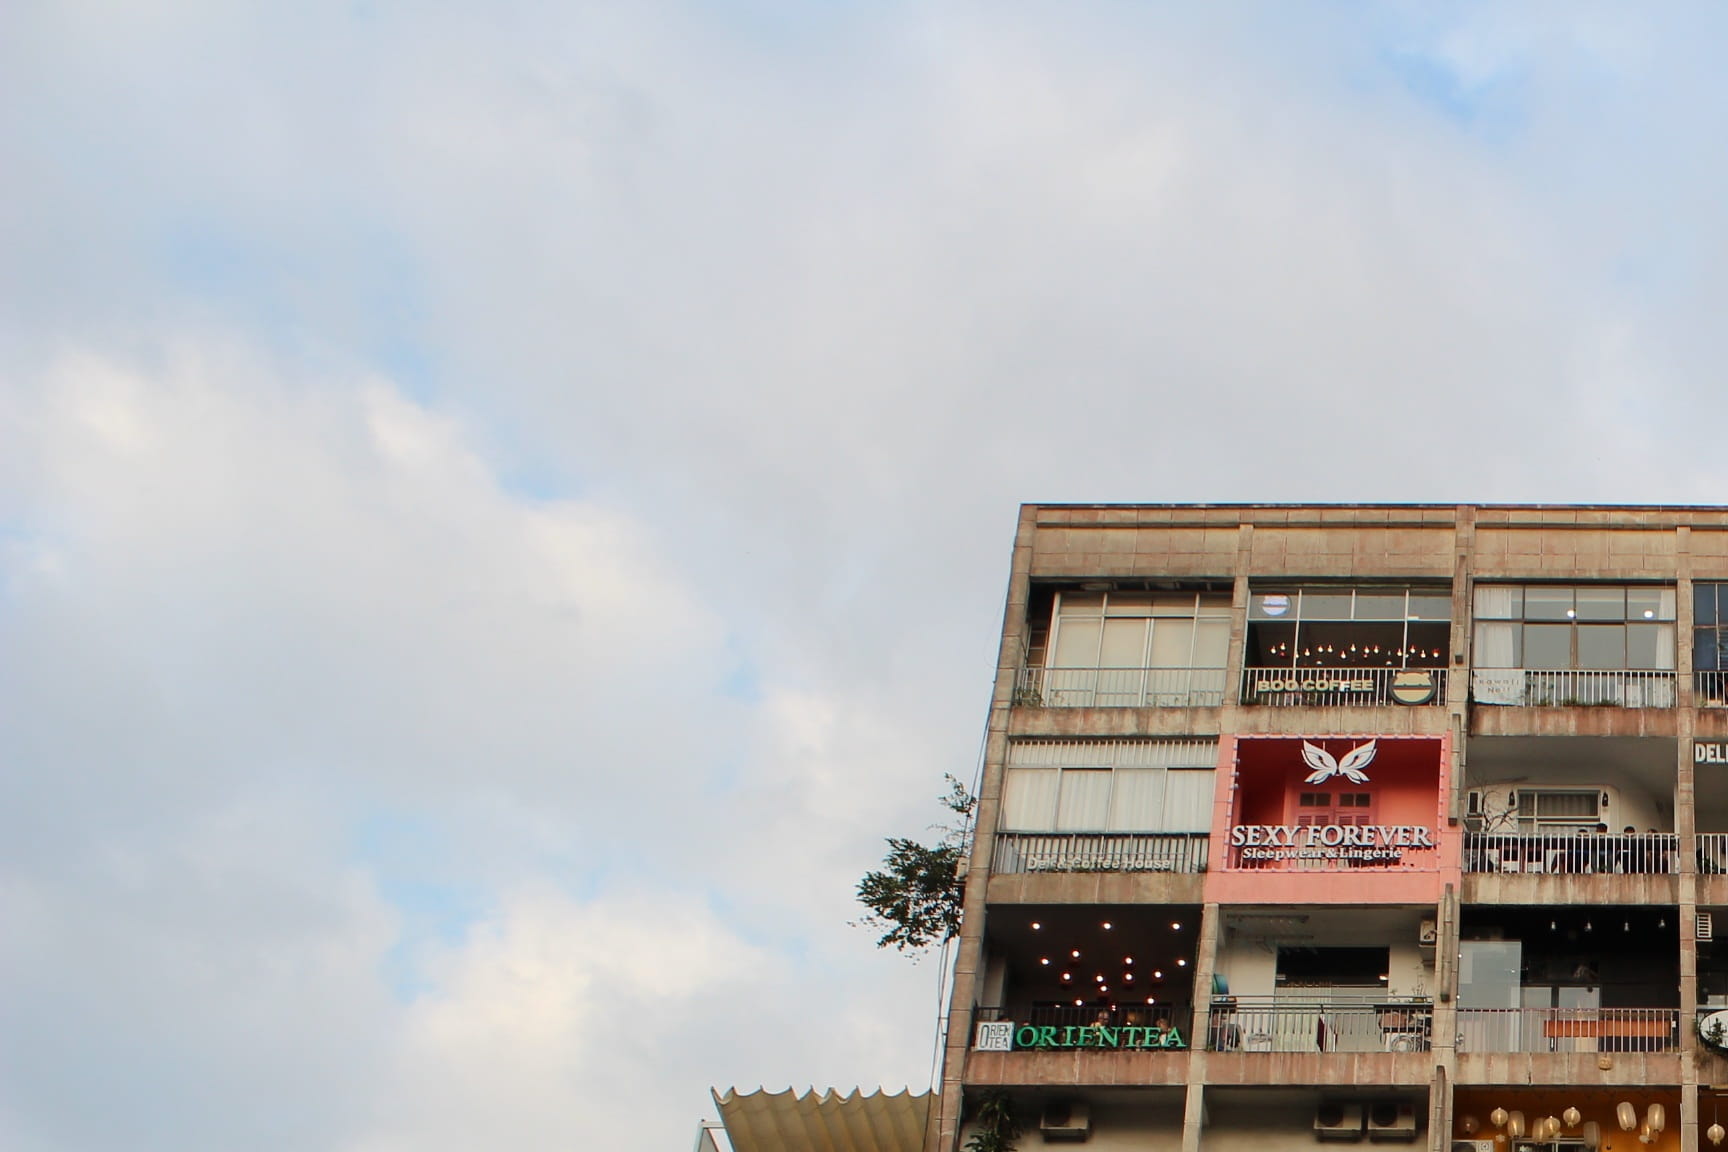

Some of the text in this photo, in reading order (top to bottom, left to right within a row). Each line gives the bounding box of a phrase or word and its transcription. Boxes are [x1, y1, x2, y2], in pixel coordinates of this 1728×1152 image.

[1258, 680, 1374, 692] BOO COFFEE
[1231, 825, 1433, 847] SEXY FOREVER
[1016, 1025, 1187, 1047] ORIENTEA
